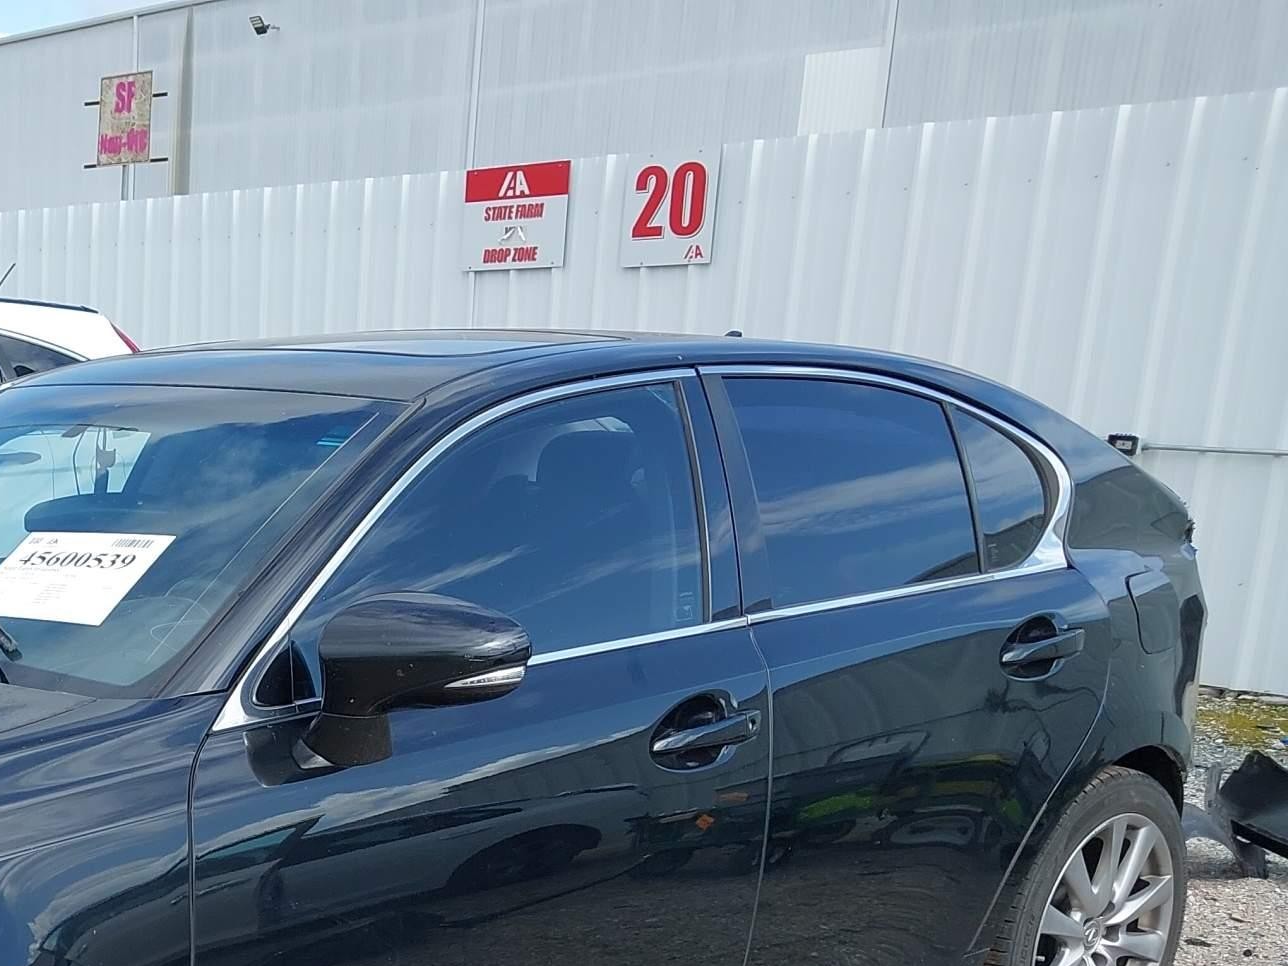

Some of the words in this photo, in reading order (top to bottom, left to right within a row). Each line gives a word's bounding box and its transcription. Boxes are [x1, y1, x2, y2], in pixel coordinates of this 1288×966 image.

[114, 80, 136, 113] SF
[631, 161, 708, 241] 20
[484, 204, 514, 222] STATE
[514, 202, 544, 221] FARM
[483, 247, 511, 264] DROP
[512, 246, 538, 263] ZONE
[19, 550, 136, 570] 45600539
